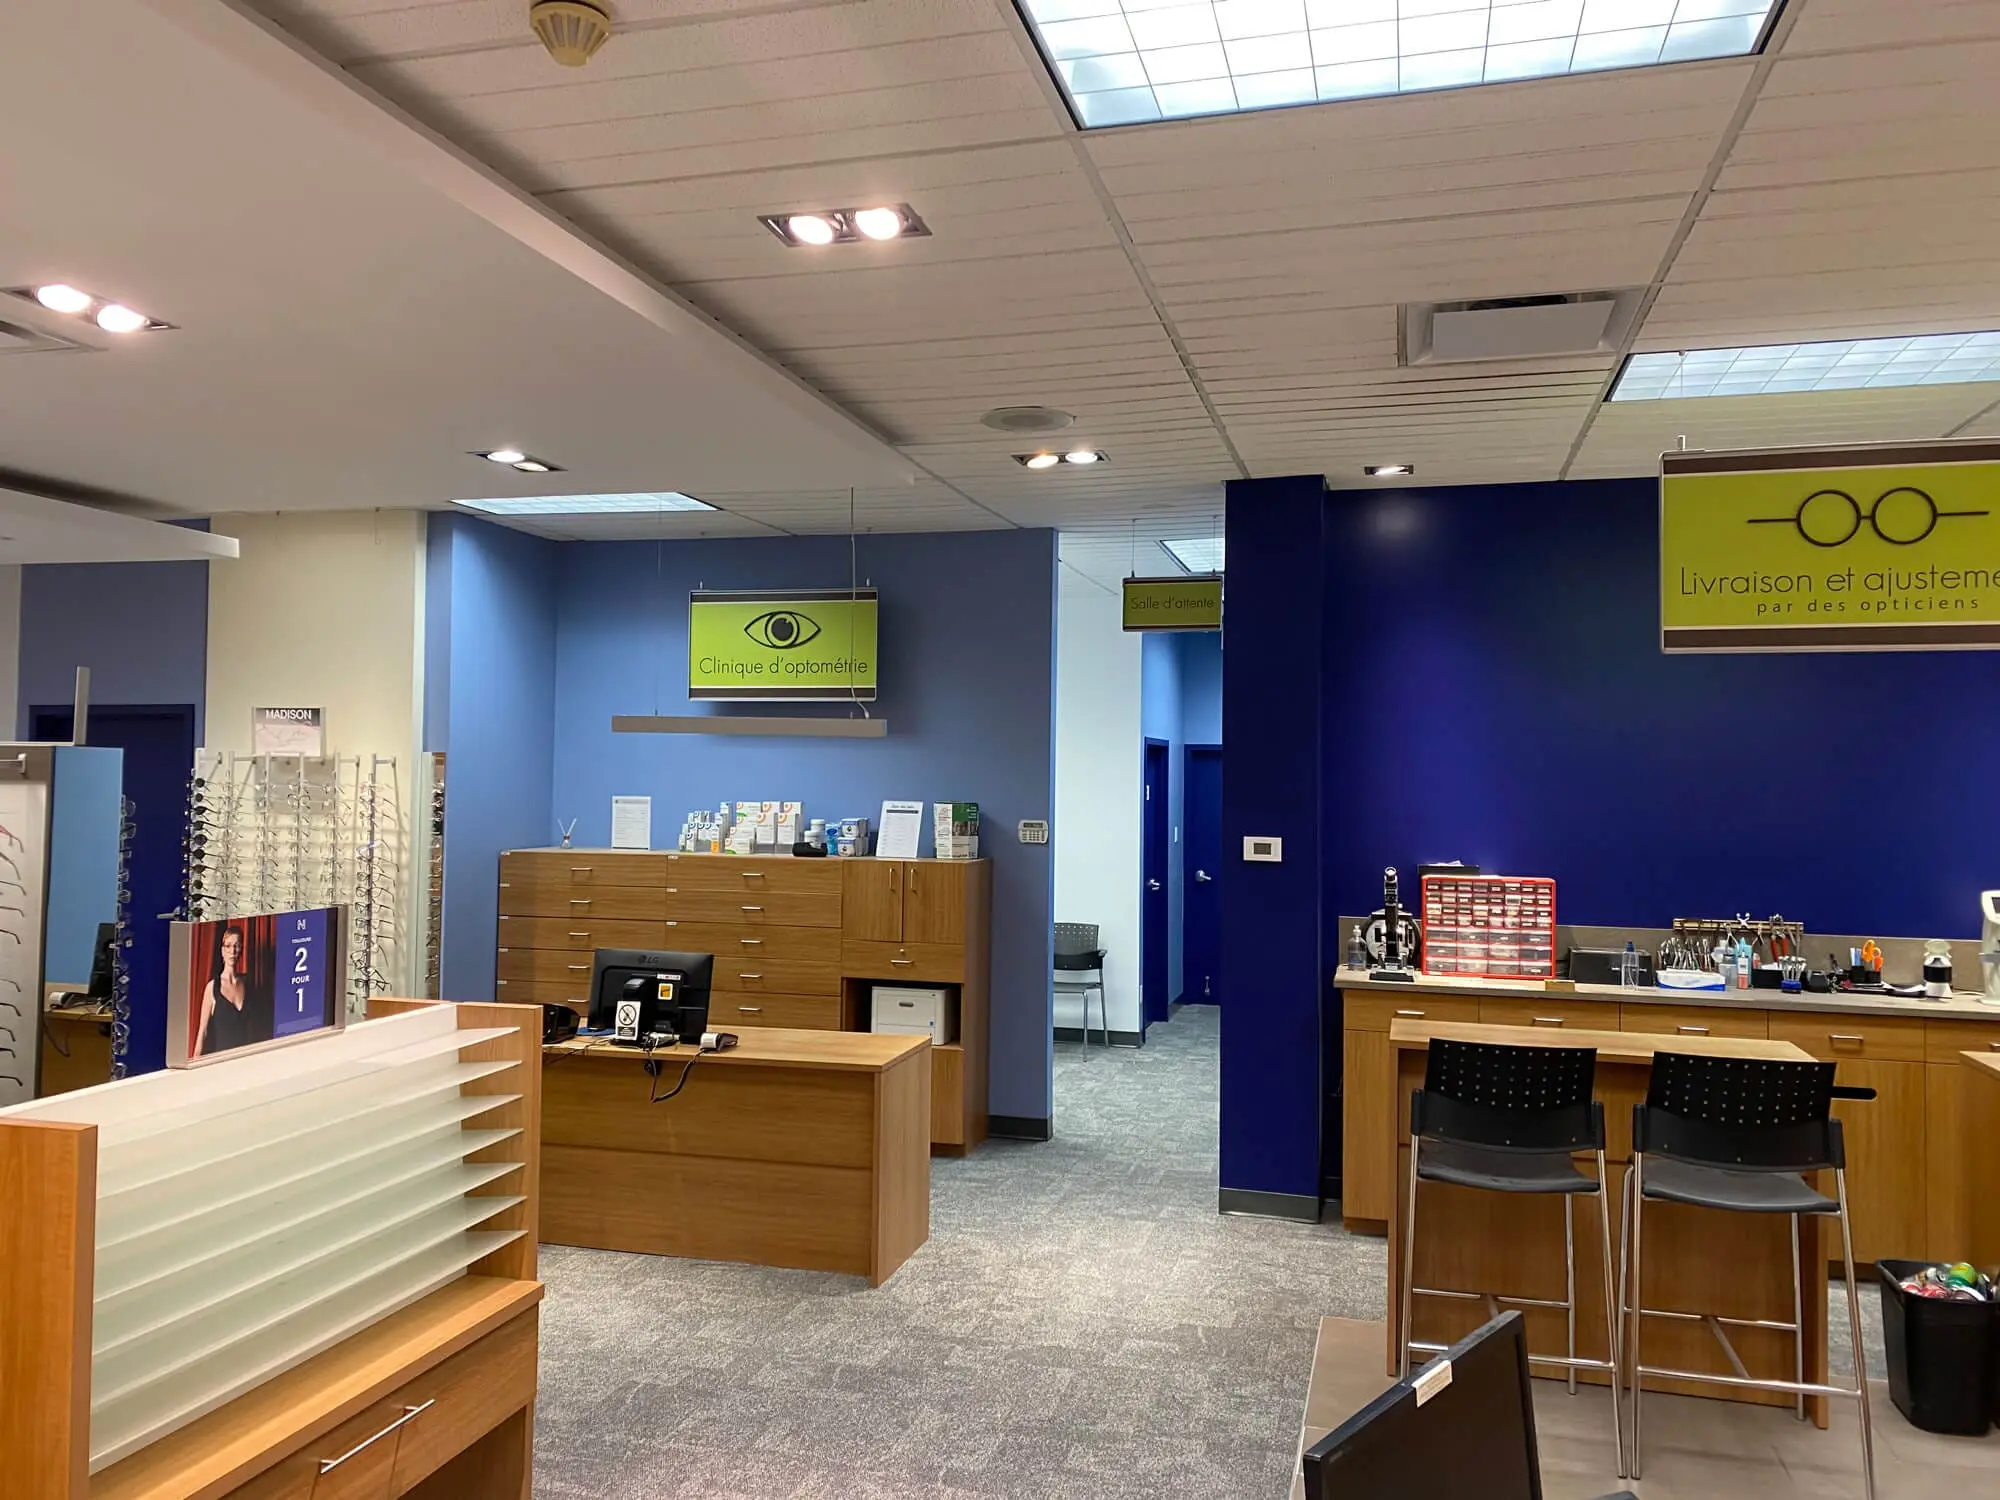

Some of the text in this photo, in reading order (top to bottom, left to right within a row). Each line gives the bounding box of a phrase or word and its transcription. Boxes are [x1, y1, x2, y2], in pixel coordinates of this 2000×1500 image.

[1680, 566, 1813, 595] Livraison
[1825, 567, 1856, 592] et
[1130, 595, 1215, 611] Salle d'attente
[1757, 597, 1979, 616] par des opticiens
[699, 655, 868, 679] Clinique d'optométrie
[265, 709, 312, 720] MADISON
[294, 946, 309, 973] 2
[291, 974, 310, 985] POUR
[295, 987, 304, 1012] 1
